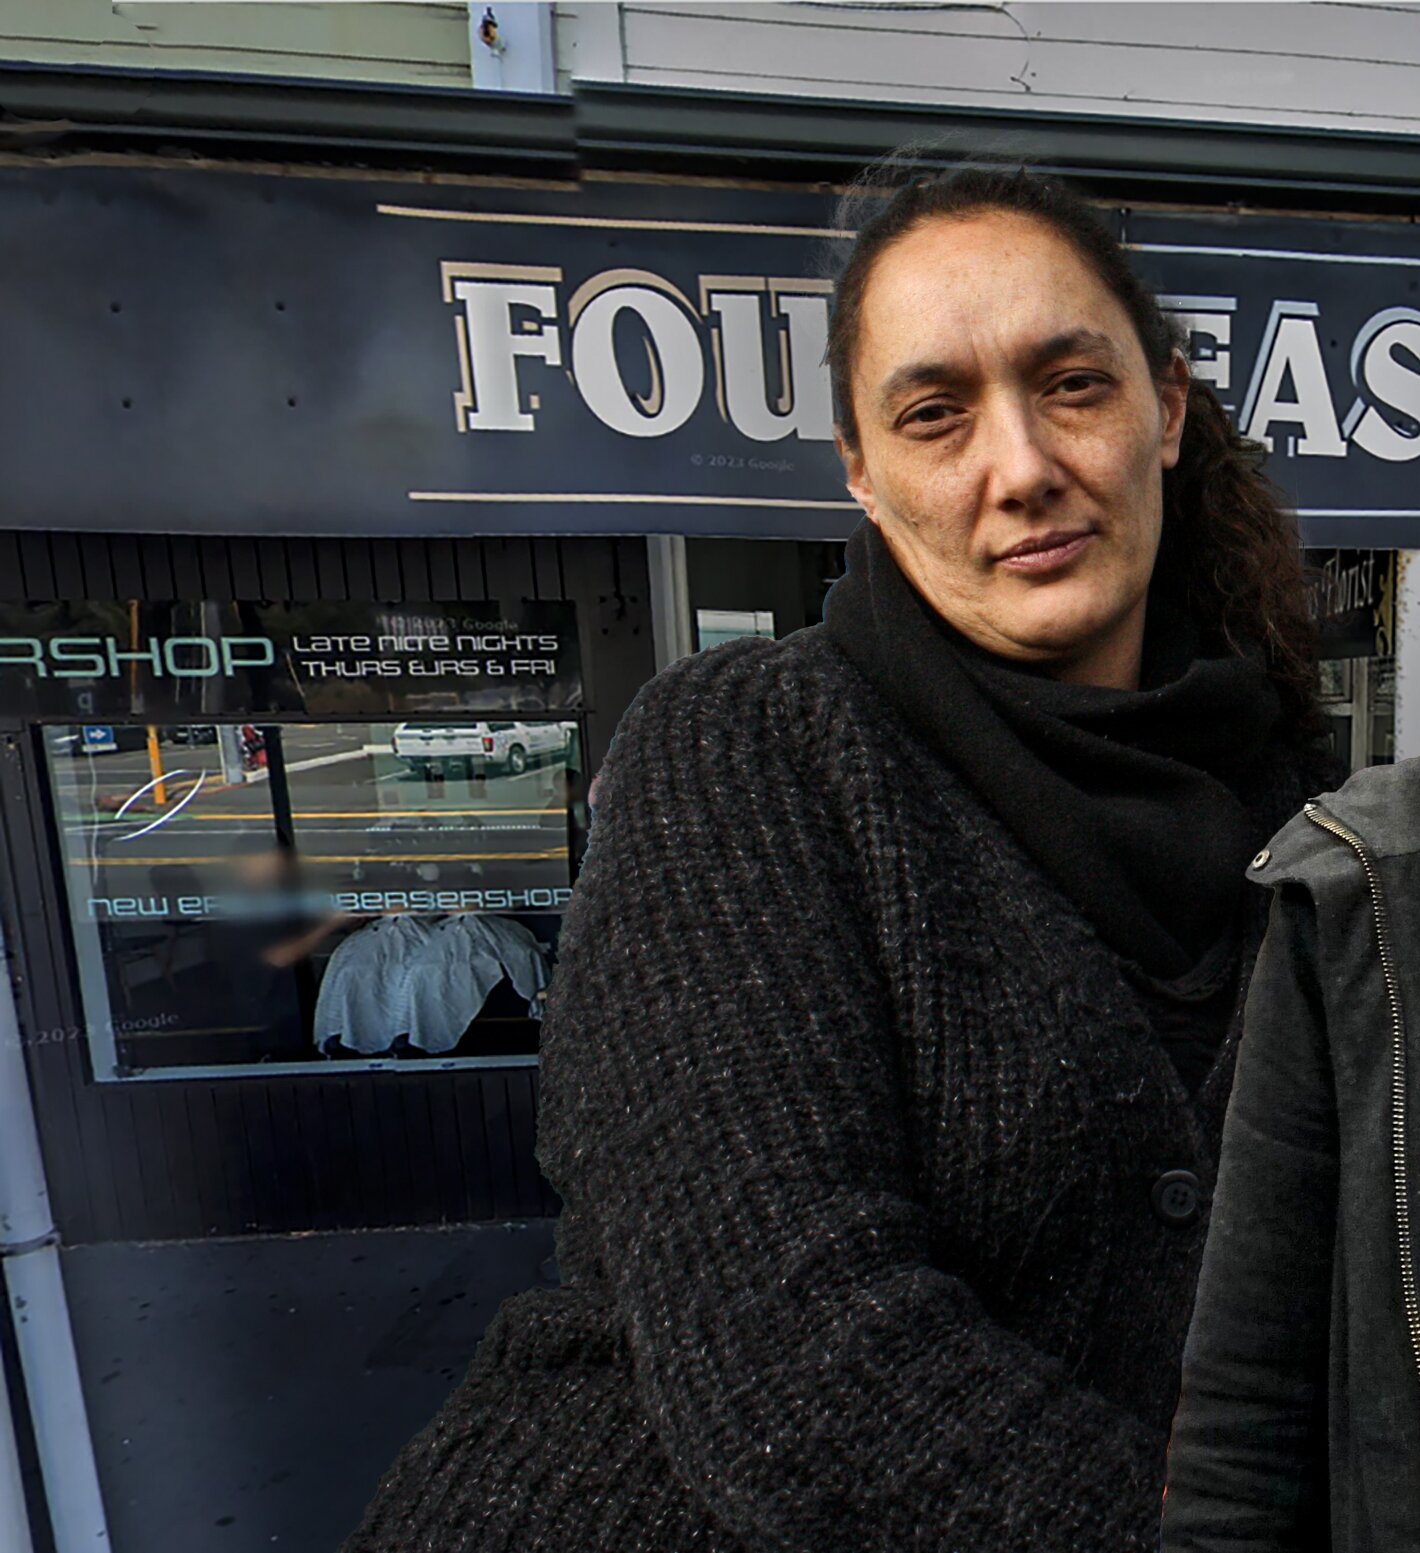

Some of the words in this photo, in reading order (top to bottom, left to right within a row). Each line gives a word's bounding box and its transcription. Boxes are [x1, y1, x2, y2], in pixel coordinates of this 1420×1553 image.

[440, 261, 834, 441] FOU
[301, 660, 401, 676] THURS
[511, 659, 556, 676] FRI
